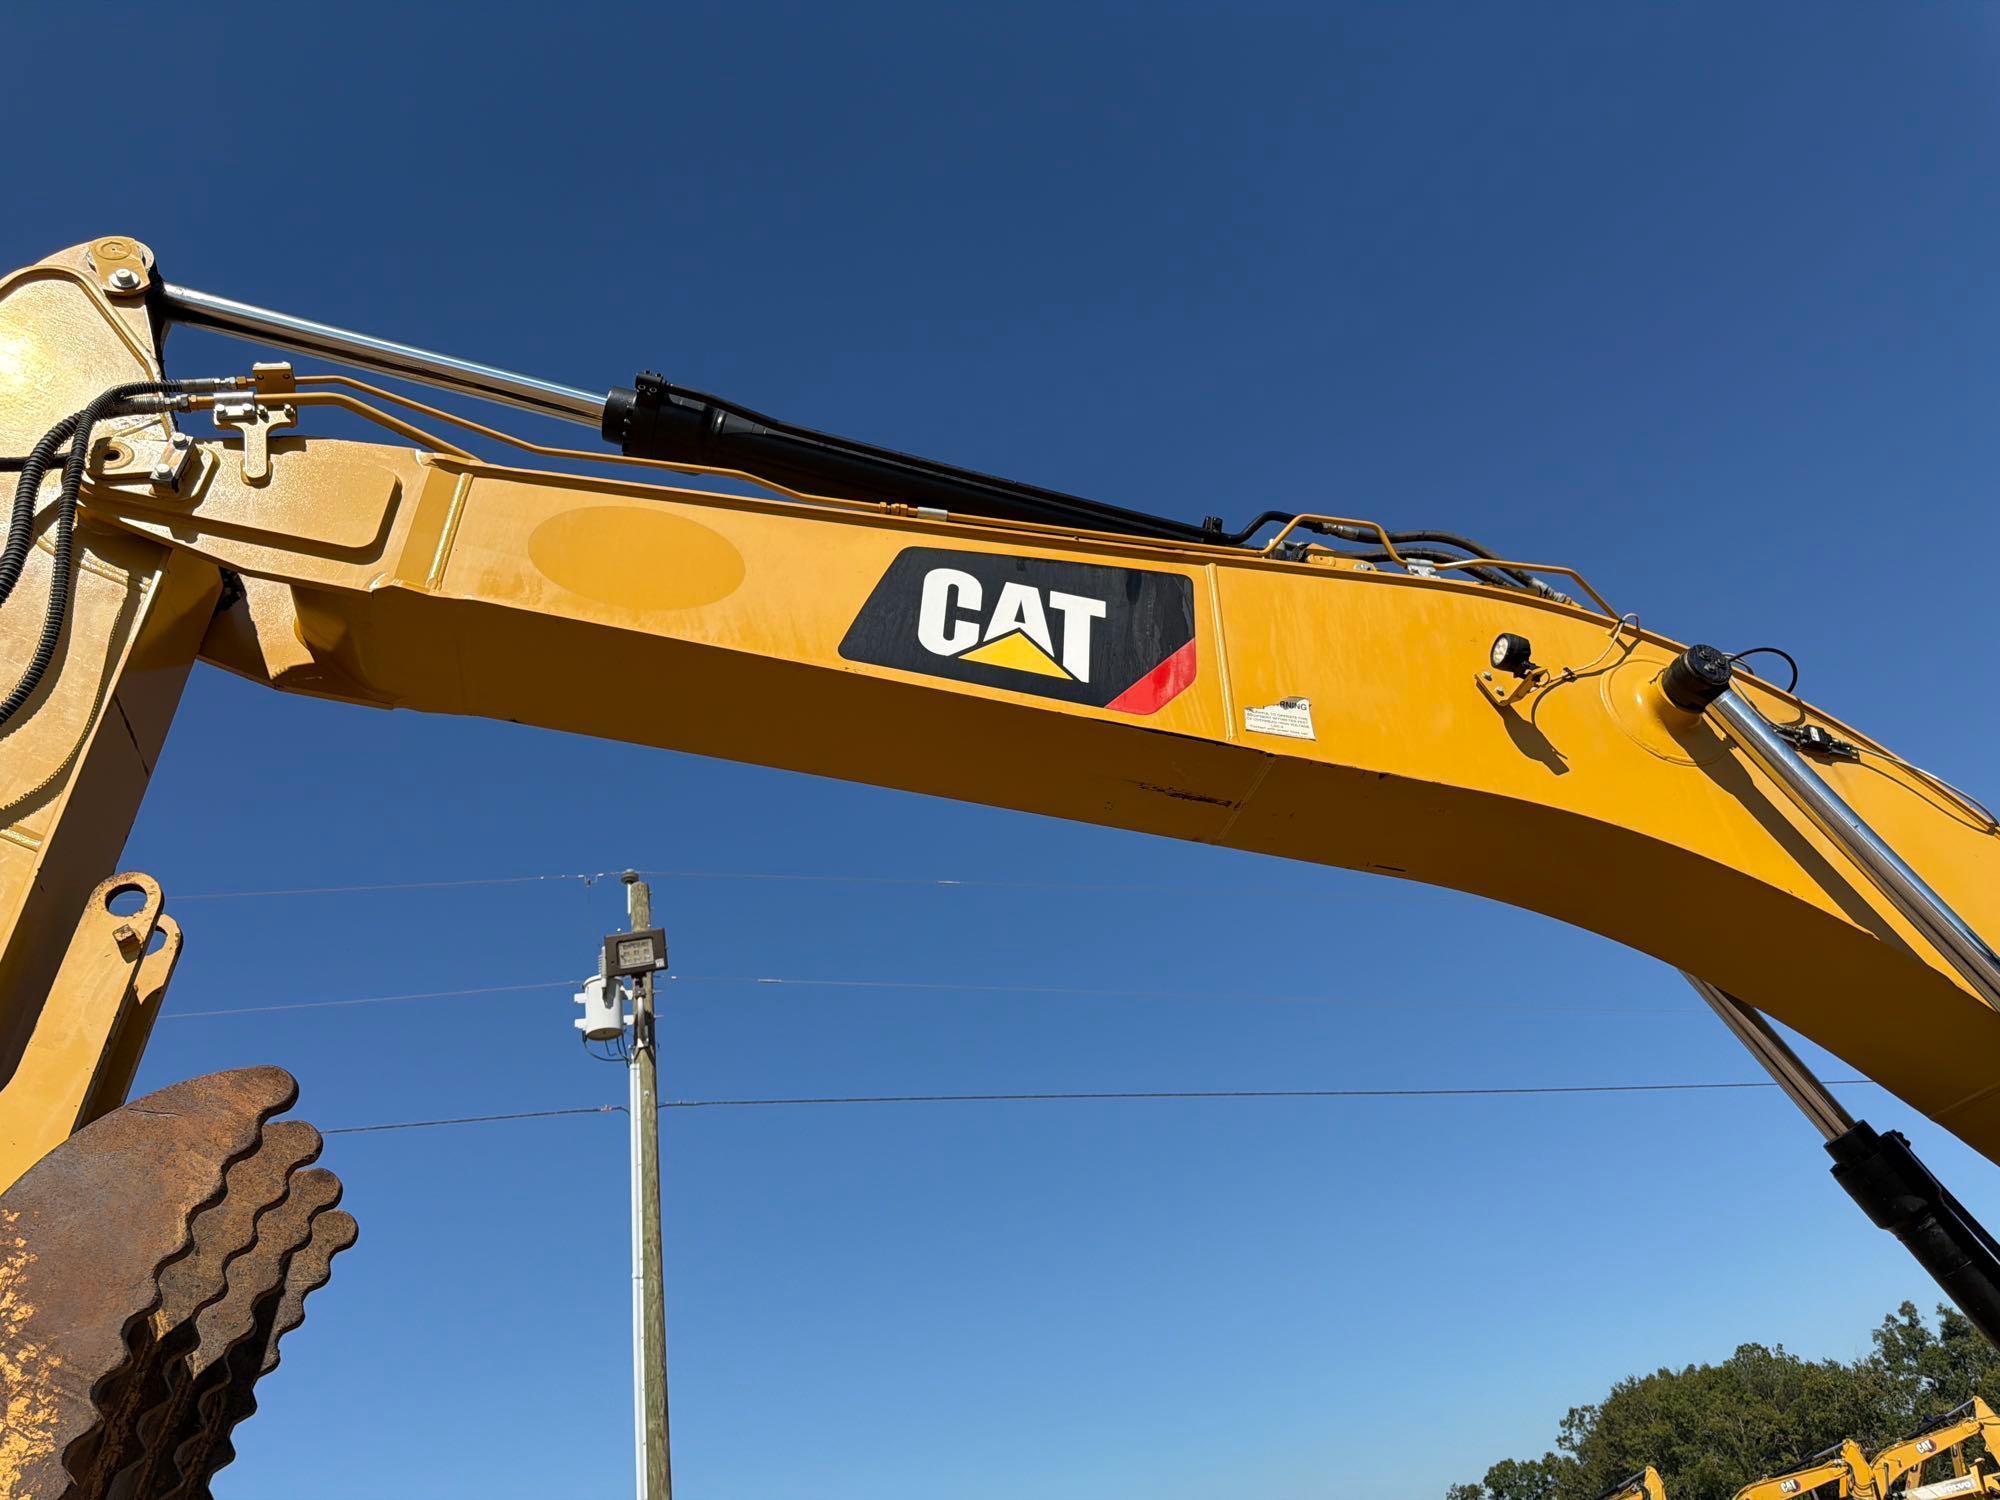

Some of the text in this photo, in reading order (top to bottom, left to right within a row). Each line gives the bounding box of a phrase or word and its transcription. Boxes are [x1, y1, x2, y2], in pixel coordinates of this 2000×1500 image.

[917, 567, 1107, 683] CAT
[1916, 1440, 1932, 1454] CAT
[1780, 1479, 1797, 1493] CAT
